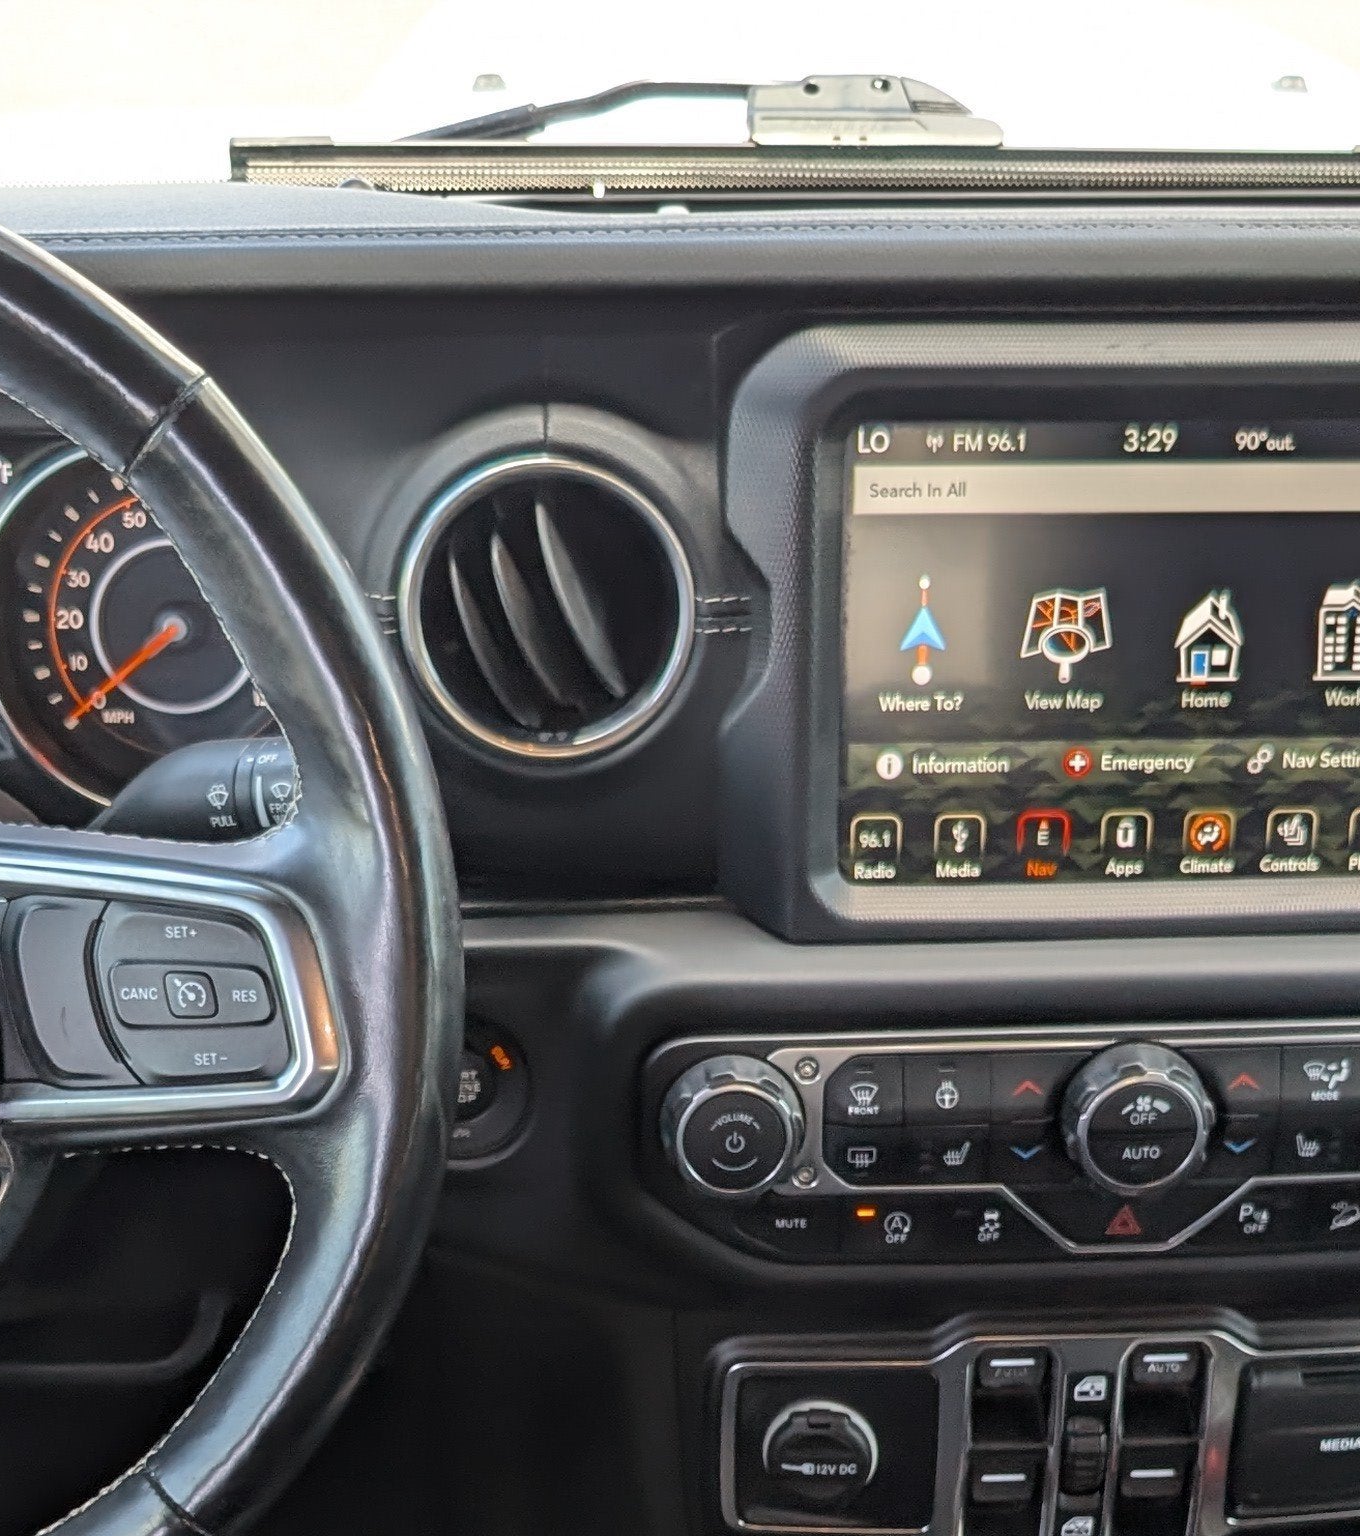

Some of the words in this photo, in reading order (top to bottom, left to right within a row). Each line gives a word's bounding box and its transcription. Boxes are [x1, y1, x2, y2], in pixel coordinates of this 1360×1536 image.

[857, 427, 890, 454] LO
[952, 430, 983, 452] FM
[987, 430, 1027, 452] 96.1
[1124, 424, 1177, 453] 3:29
[869, 483, 922, 498] Search
[927, 483, 941, 498] In
[946, 482, 967, 498] All
[122, 511, 147, 528] 50
[86, 532, 115, 553] 40
[67, 569, 91, 588] 30
[56, 609, 84, 630] 20
[69, 654, 88, 672] 10
[878, 694, 929, 711] Where
[933, 694, 964, 711] To?
[1024, 692, 1062, 709] View
[1066, 692, 1103, 711] Map
[1181, 690, 1232, 708] Home
[102, 710, 135, 724] MPH
[258, 754, 278, 764] OFF
[912, 755, 1010, 774] Information
[1101, 755, 1194, 774] Emergency
[1282, 751, 1316, 768] Nav
[209, 814, 237, 828] PULL
[859, 830, 891, 848] 96.1
[853, 860, 896, 880] Radio
[935, 860, 981, 879] Media
[1026, 859, 1057, 878] Nav
[1105, 857, 1143, 877] Apps
[1180, 857, 1234, 874] Climate
[1260, 856, 1319, 873] Controls
[121, 987, 158, 1001] CANC
[232, 990, 257, 1003] RES
[1311, 1091, 1339, 1101] MODE
[848, 1106, 879, 1116] FRONT
[1130, 1112, 1157, 1125] OFF
[1122, 1146, 1161, 1160] AUTO
[775, 1218, 808, 1229] MUTE
[1243, 1222, 1267, 1234] OFF
[885, 1233, 908, 1244] OFF
[977, 1232, 1000, 1243] OFF
[1147, 1361, 1181, 1373] AUTO
[816, 1463, 836, 1475] 12V
